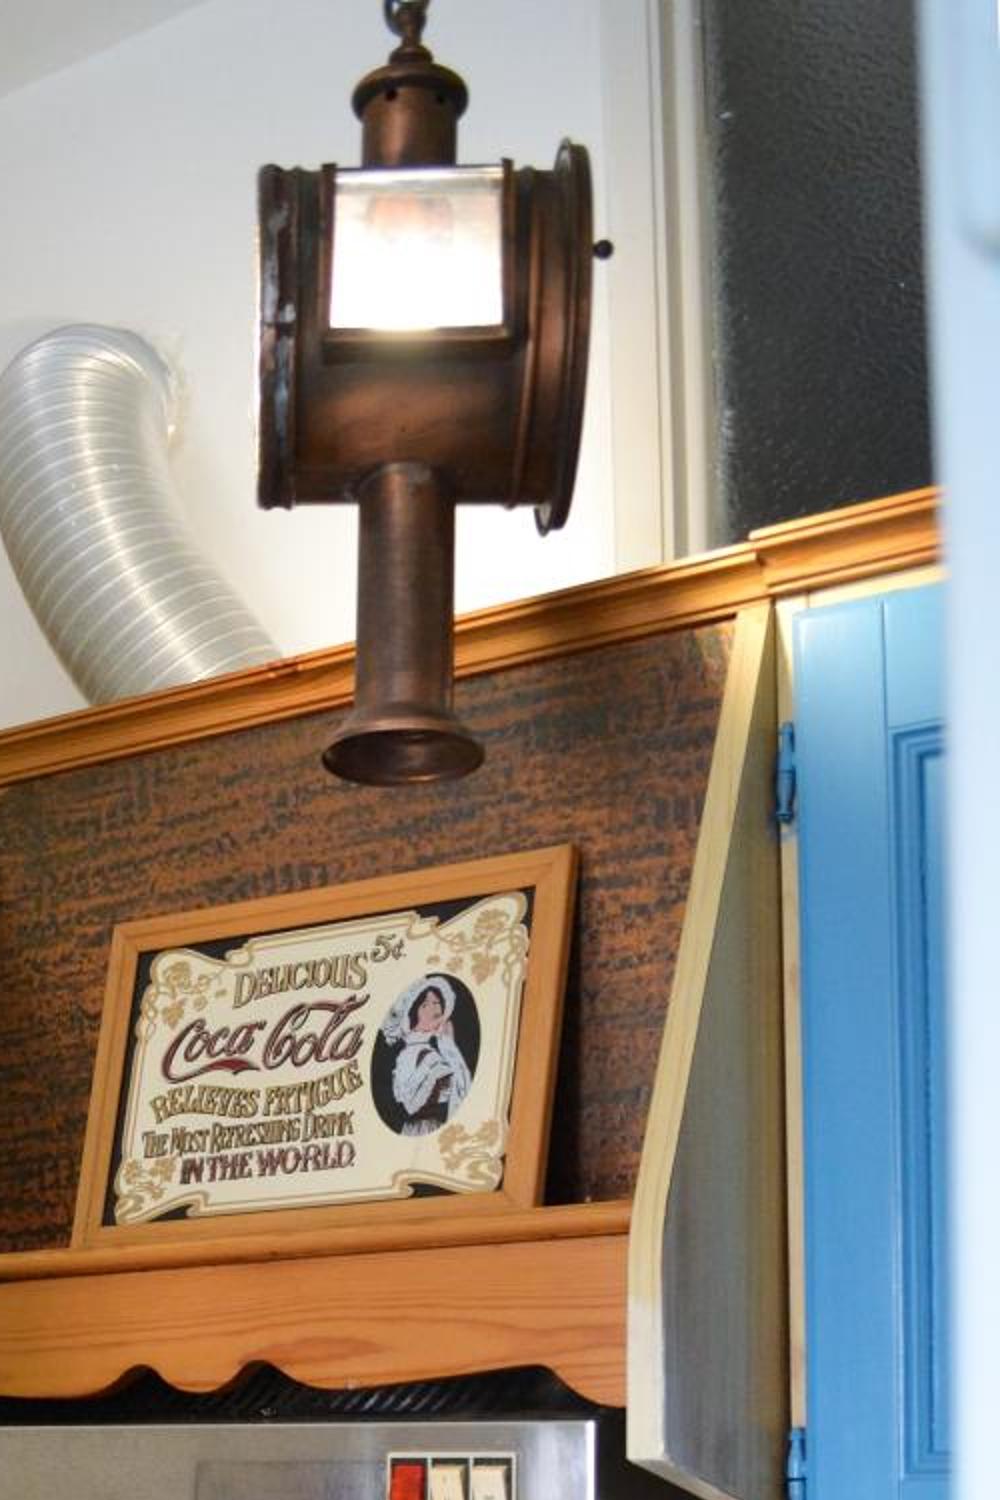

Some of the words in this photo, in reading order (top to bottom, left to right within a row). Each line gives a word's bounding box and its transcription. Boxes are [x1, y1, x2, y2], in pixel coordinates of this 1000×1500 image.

[232, 952, 368, 1010] DELICIOUS
[150, 1084, 261, 1124] RELIEVES
[263, 1059, 363, 1116] FATIGUE
[171, 1125, 212, 1155] MOST
[211, 1119, 301, 1153] REFRESHING
[300, 1110, 355, 1142] DRINK
[180, 1156, 205, 1185] IN
[206, 1152, 253, 1182] THE
